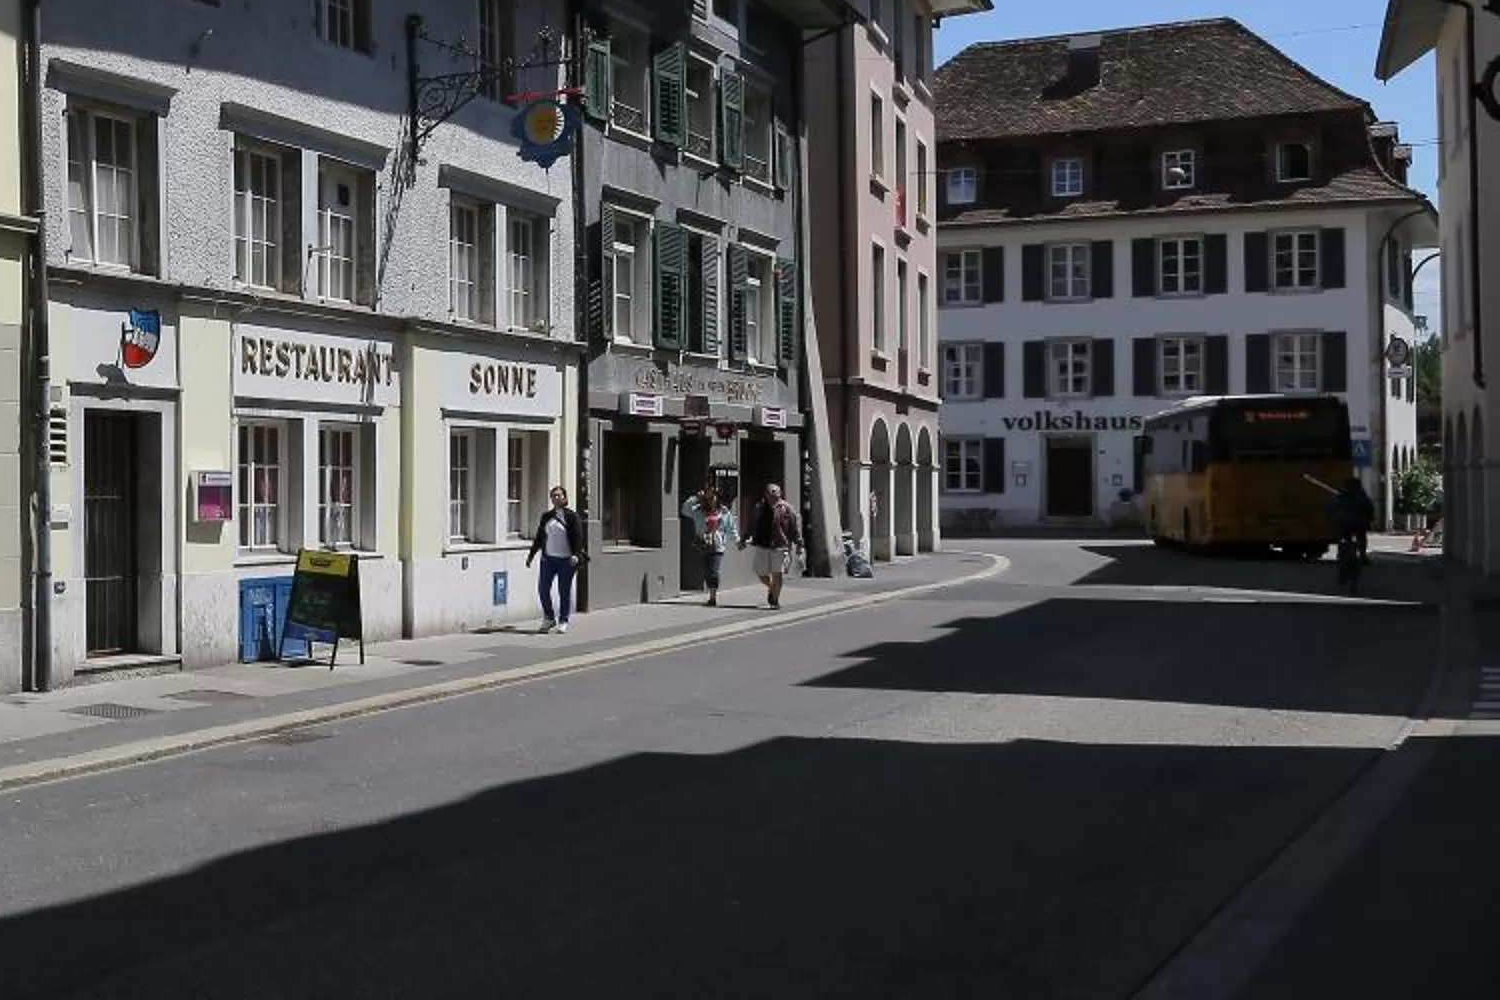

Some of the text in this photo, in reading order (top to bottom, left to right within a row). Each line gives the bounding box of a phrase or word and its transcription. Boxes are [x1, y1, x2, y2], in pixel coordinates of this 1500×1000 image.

[241, 335, 396, 387] RESTAURANT
[469, 362, 537, 398] SONNE
[1002, 410, 1143, 431] volkshaus
